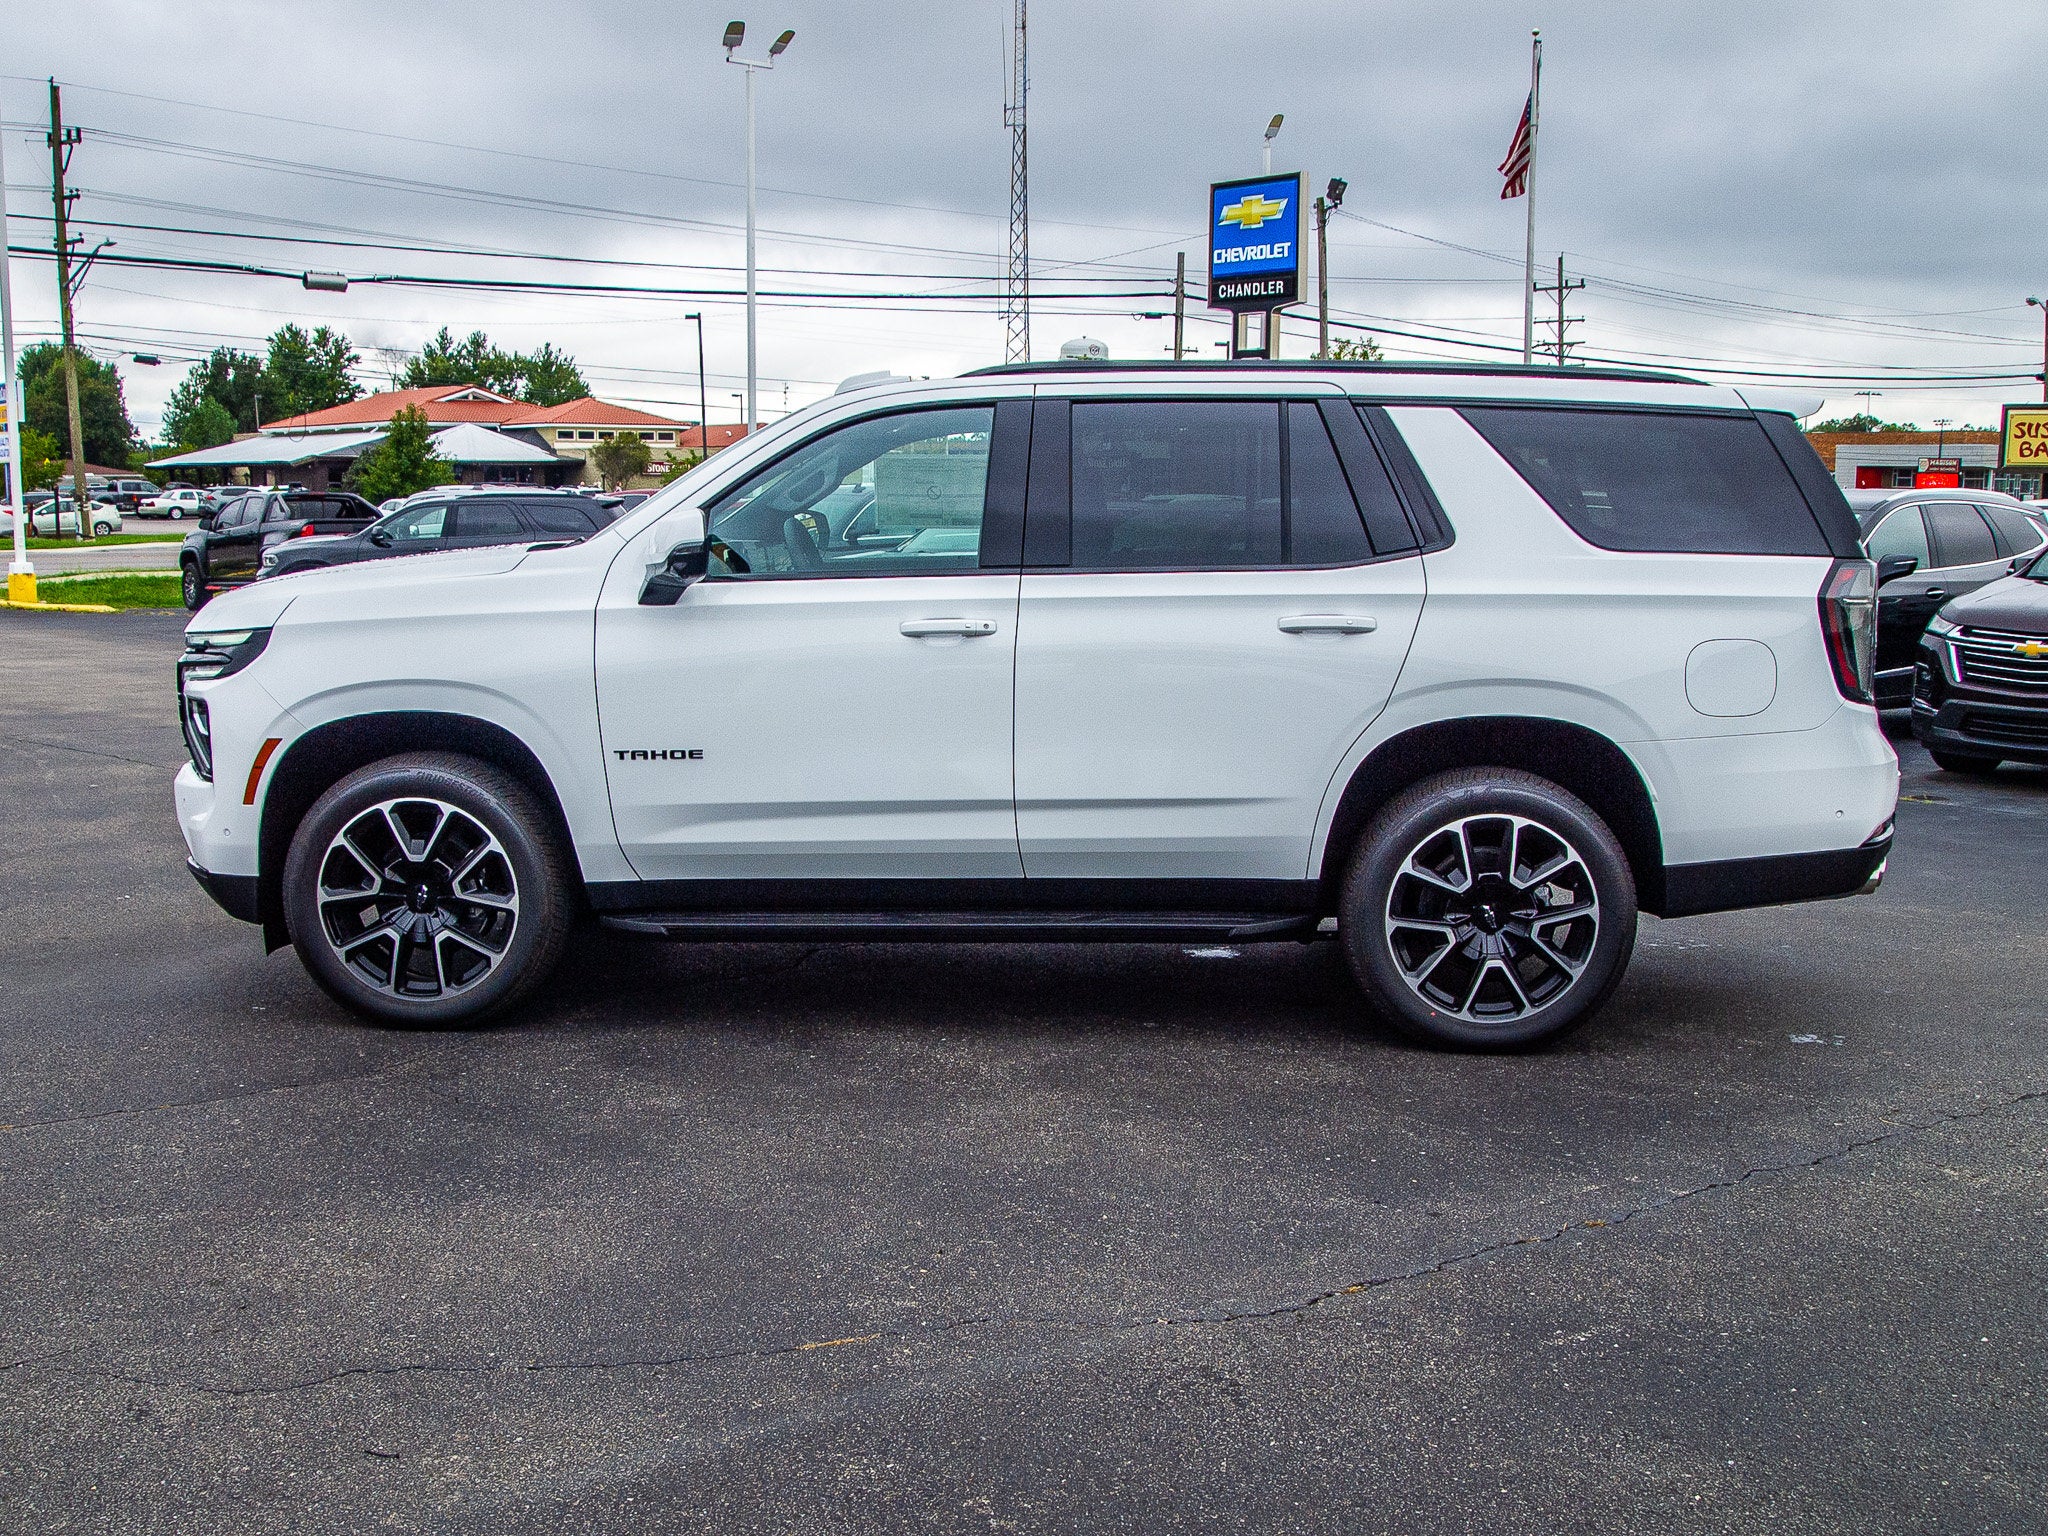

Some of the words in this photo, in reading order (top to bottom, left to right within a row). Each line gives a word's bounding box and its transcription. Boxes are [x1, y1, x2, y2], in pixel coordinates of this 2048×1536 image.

[1213, 242, 1291, 264] CHEVROLET
[1218, 281, 1284, 298] CHANDLER
[647, 463, 671, 473] STONE
[613, 749, 703, 760] TAHOE
